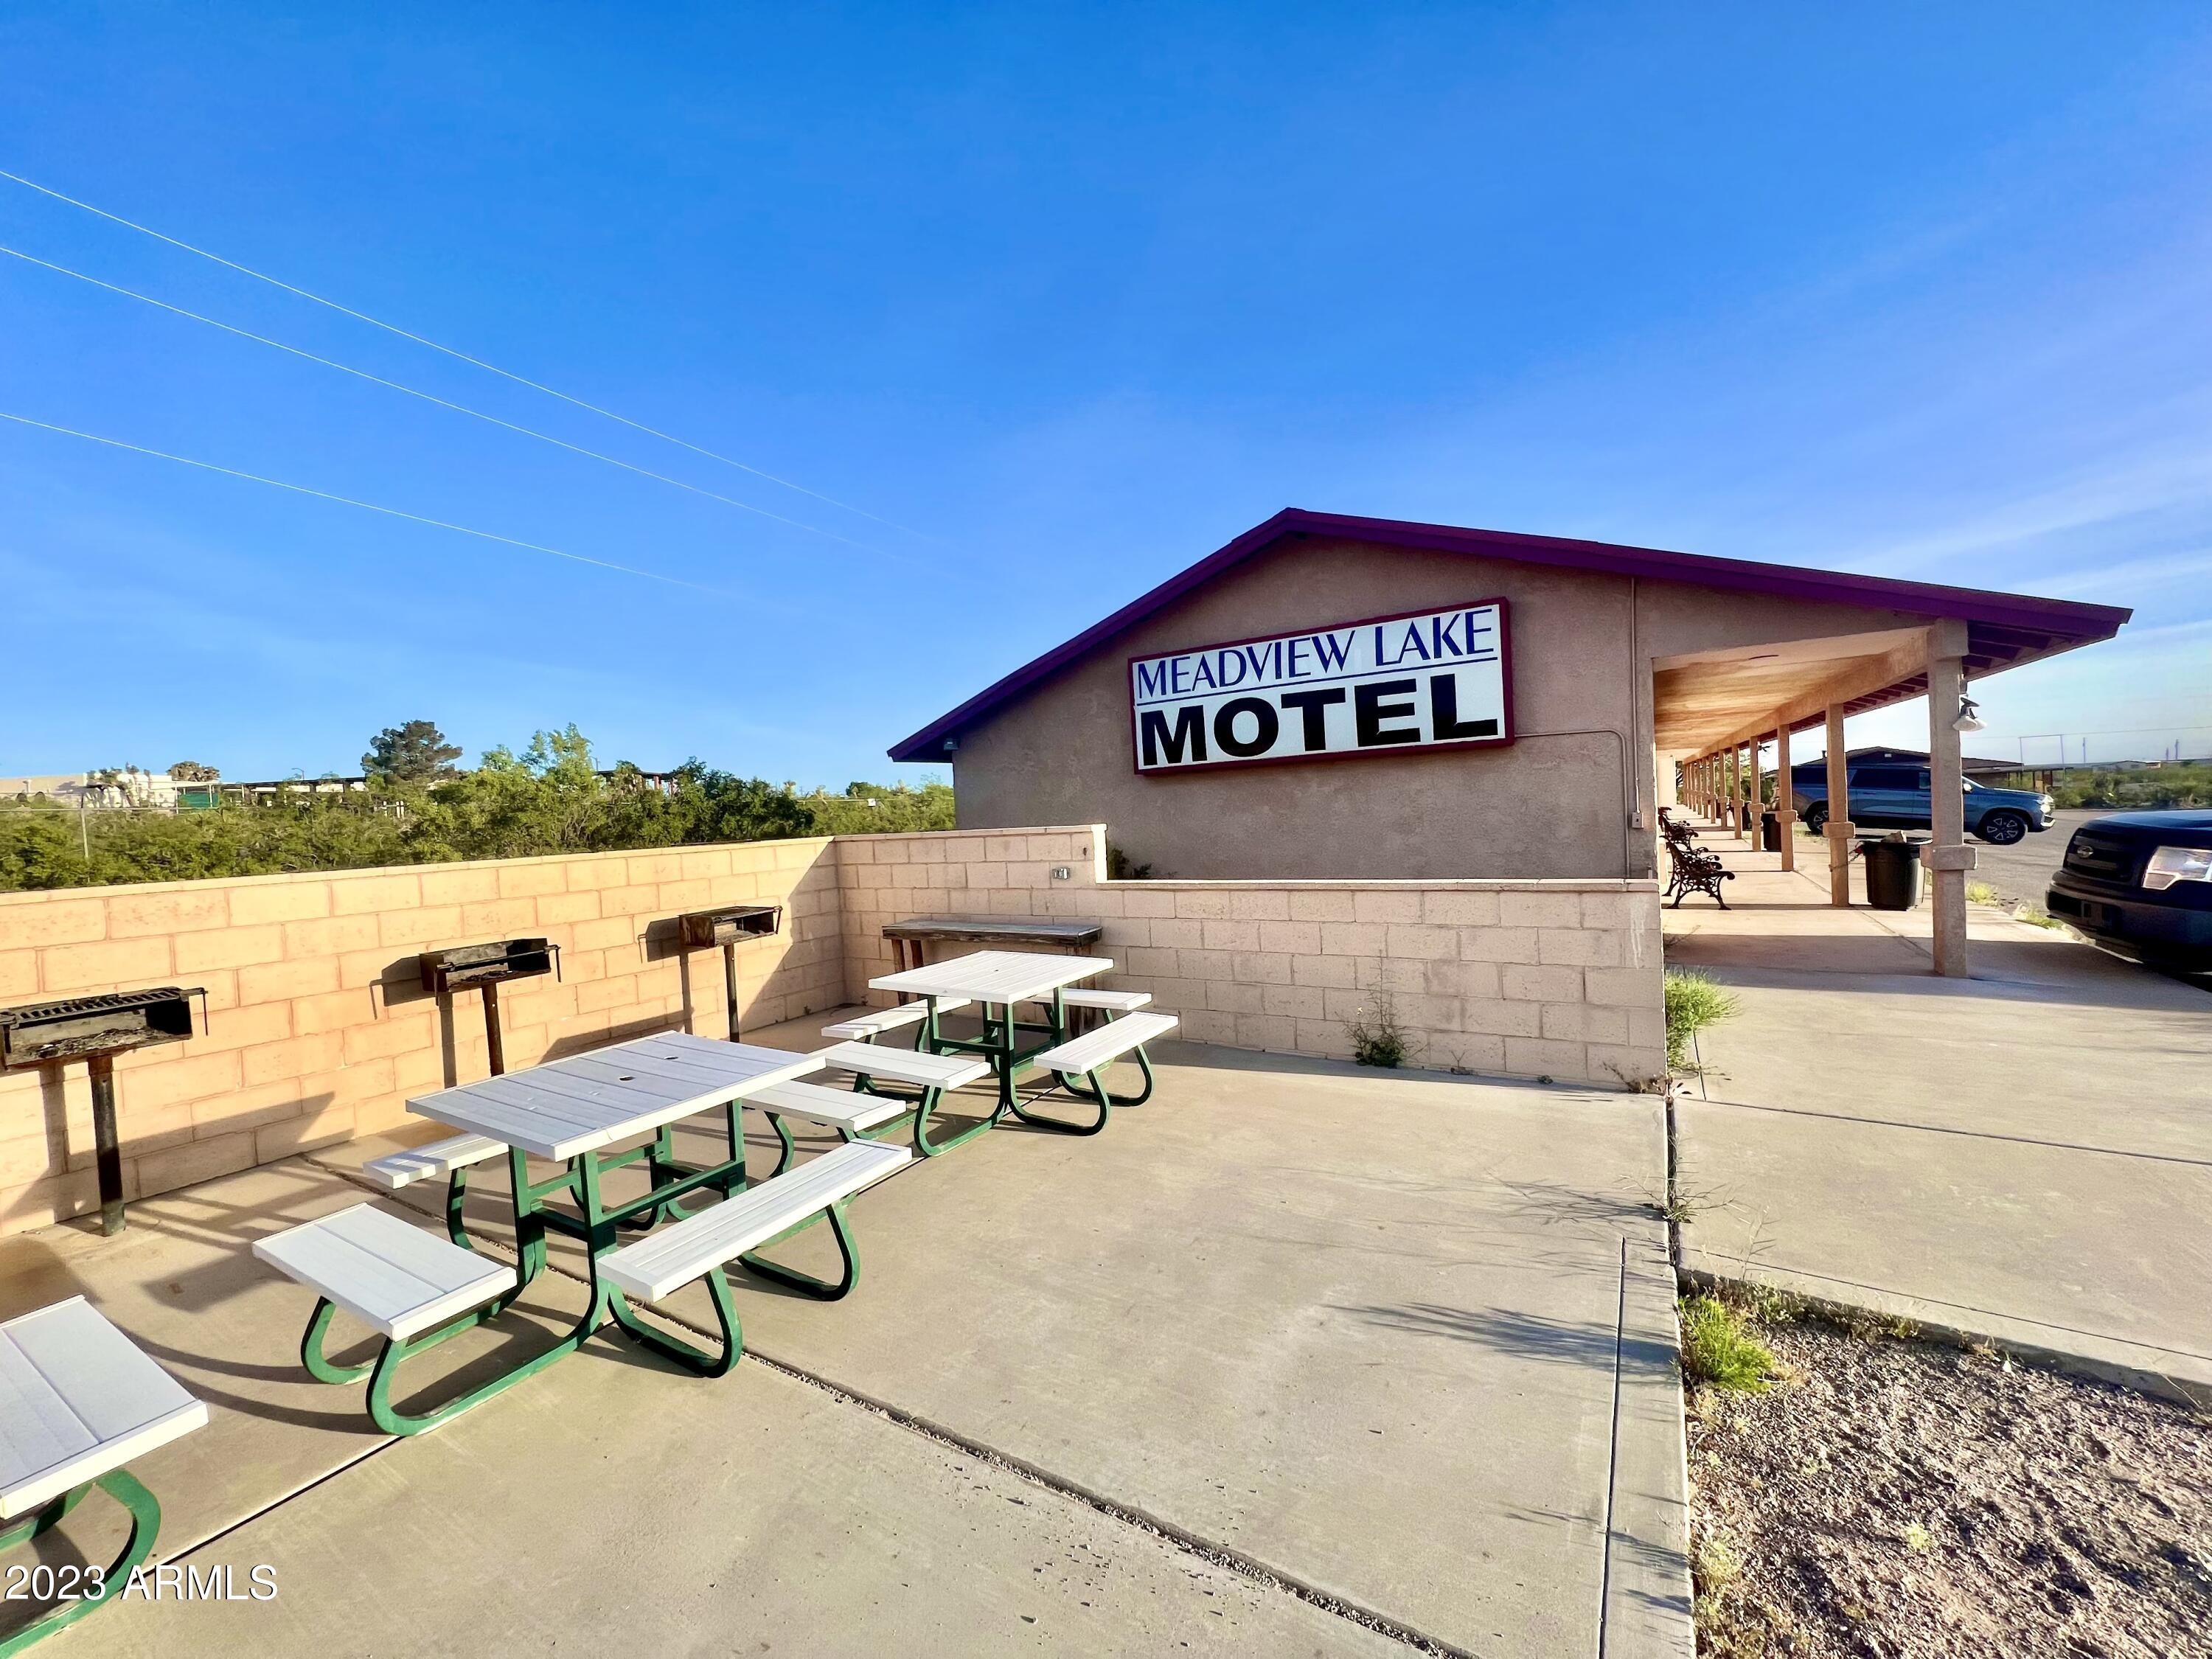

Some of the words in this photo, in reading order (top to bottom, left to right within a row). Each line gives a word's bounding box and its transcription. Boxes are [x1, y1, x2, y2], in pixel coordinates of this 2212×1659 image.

[1138, 630, 1355, 698] MEADVIEW
[1374, 608, 1495, 665] LAKE
[1141, 674, 1498, 765] MOTEL
